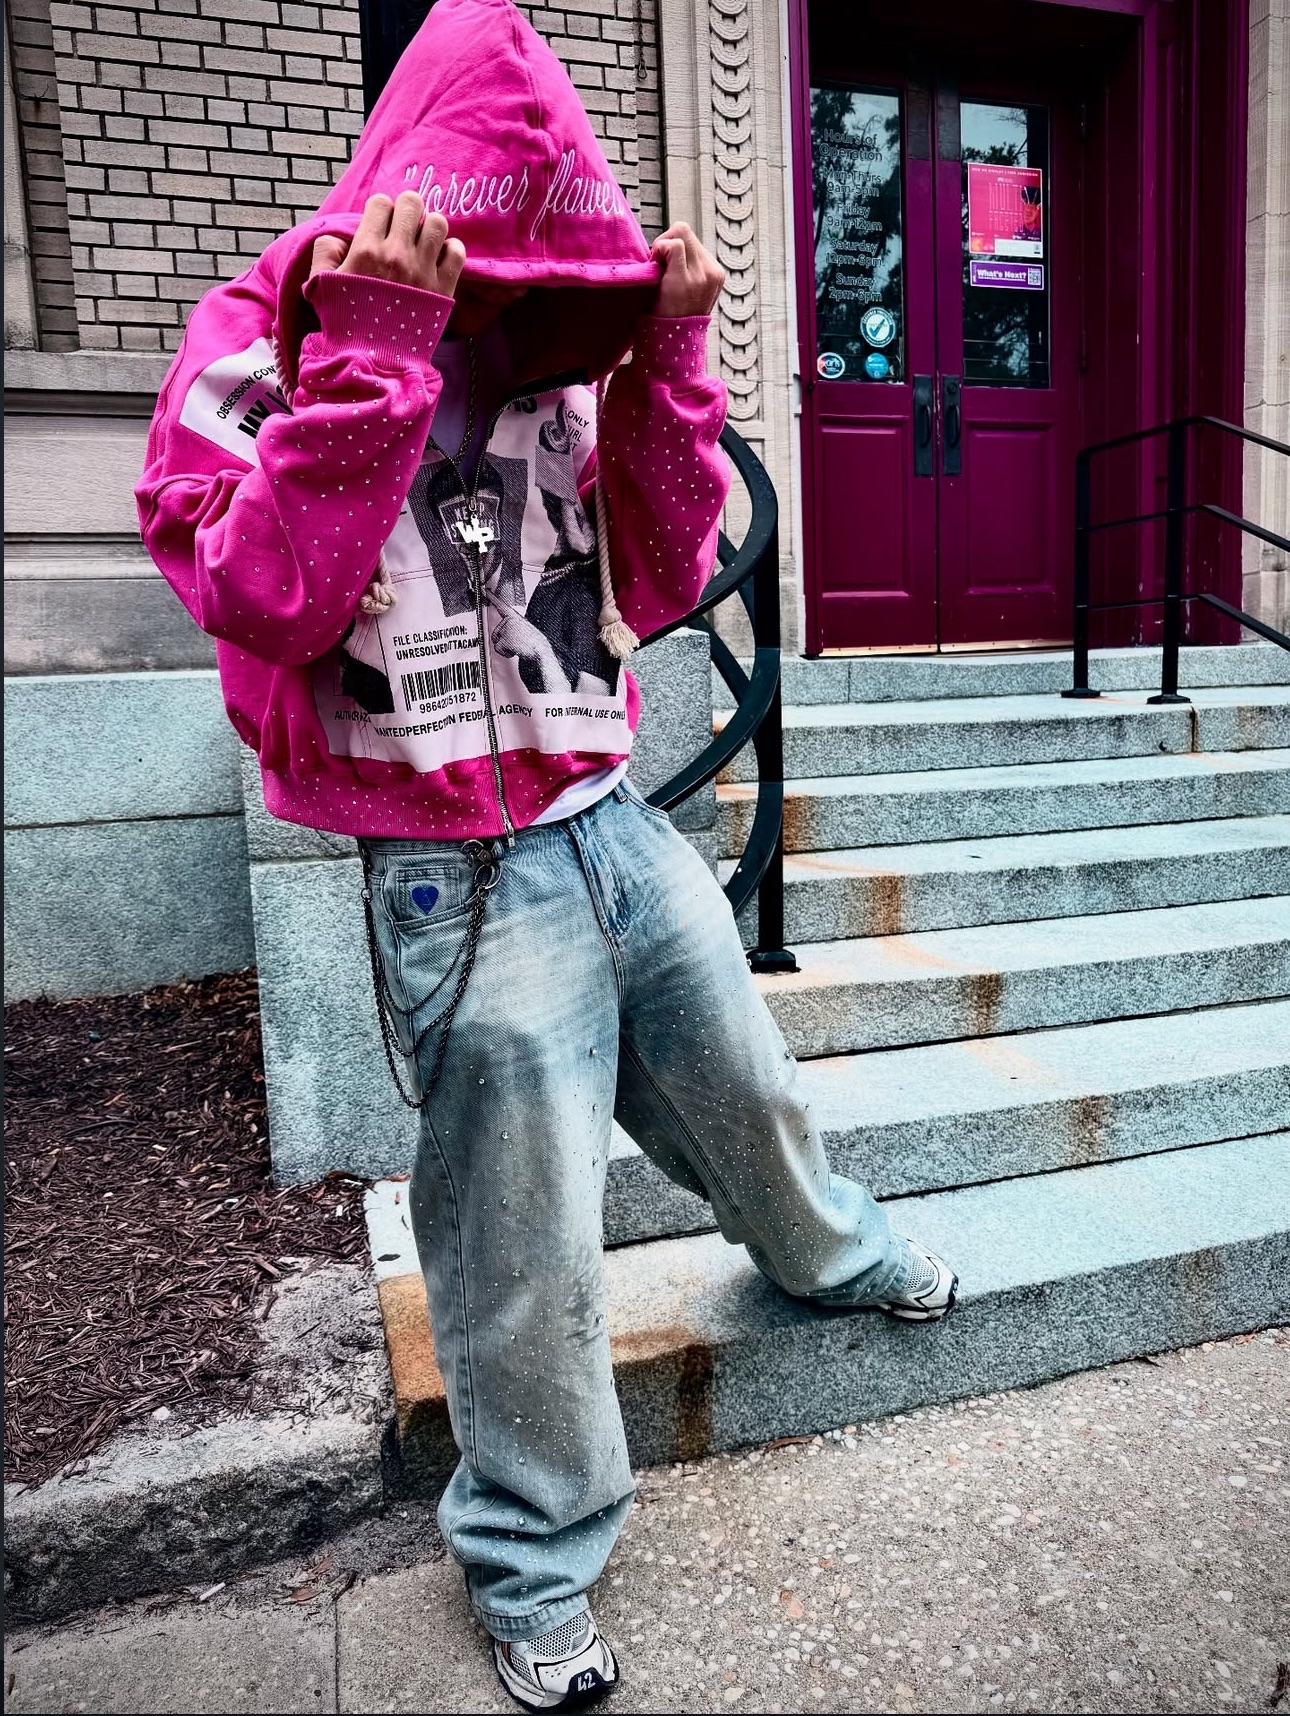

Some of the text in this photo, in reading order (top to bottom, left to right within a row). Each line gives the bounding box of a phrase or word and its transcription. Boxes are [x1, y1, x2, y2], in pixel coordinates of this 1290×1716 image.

[824, 129, 878, 147] Hours of
[819, 143, 883, 163] Operation
[824, 166, 882, 183] Mon-Thurs
[827, 182, 880, 198] 9am-5pm
[837, 202, 870, 218] Friday
[827, 215, 882, 232] 9am-12pm
[829, 238, 878, 256] Saturday
[836, 273, 876, 291] Sunday
[977, 268, 1004, 279] What's
[1004, 270, 1027, 280] Next?
[216, 375, 256, 420] OBSESSION
[567, 410, 590, 428] ONLY
[393, 634, 411, 647] FILE
[545, 707, 563, 718] FOR
[595, 709, 610, 719] USE
[577, 1672, 596, 1692] 42
